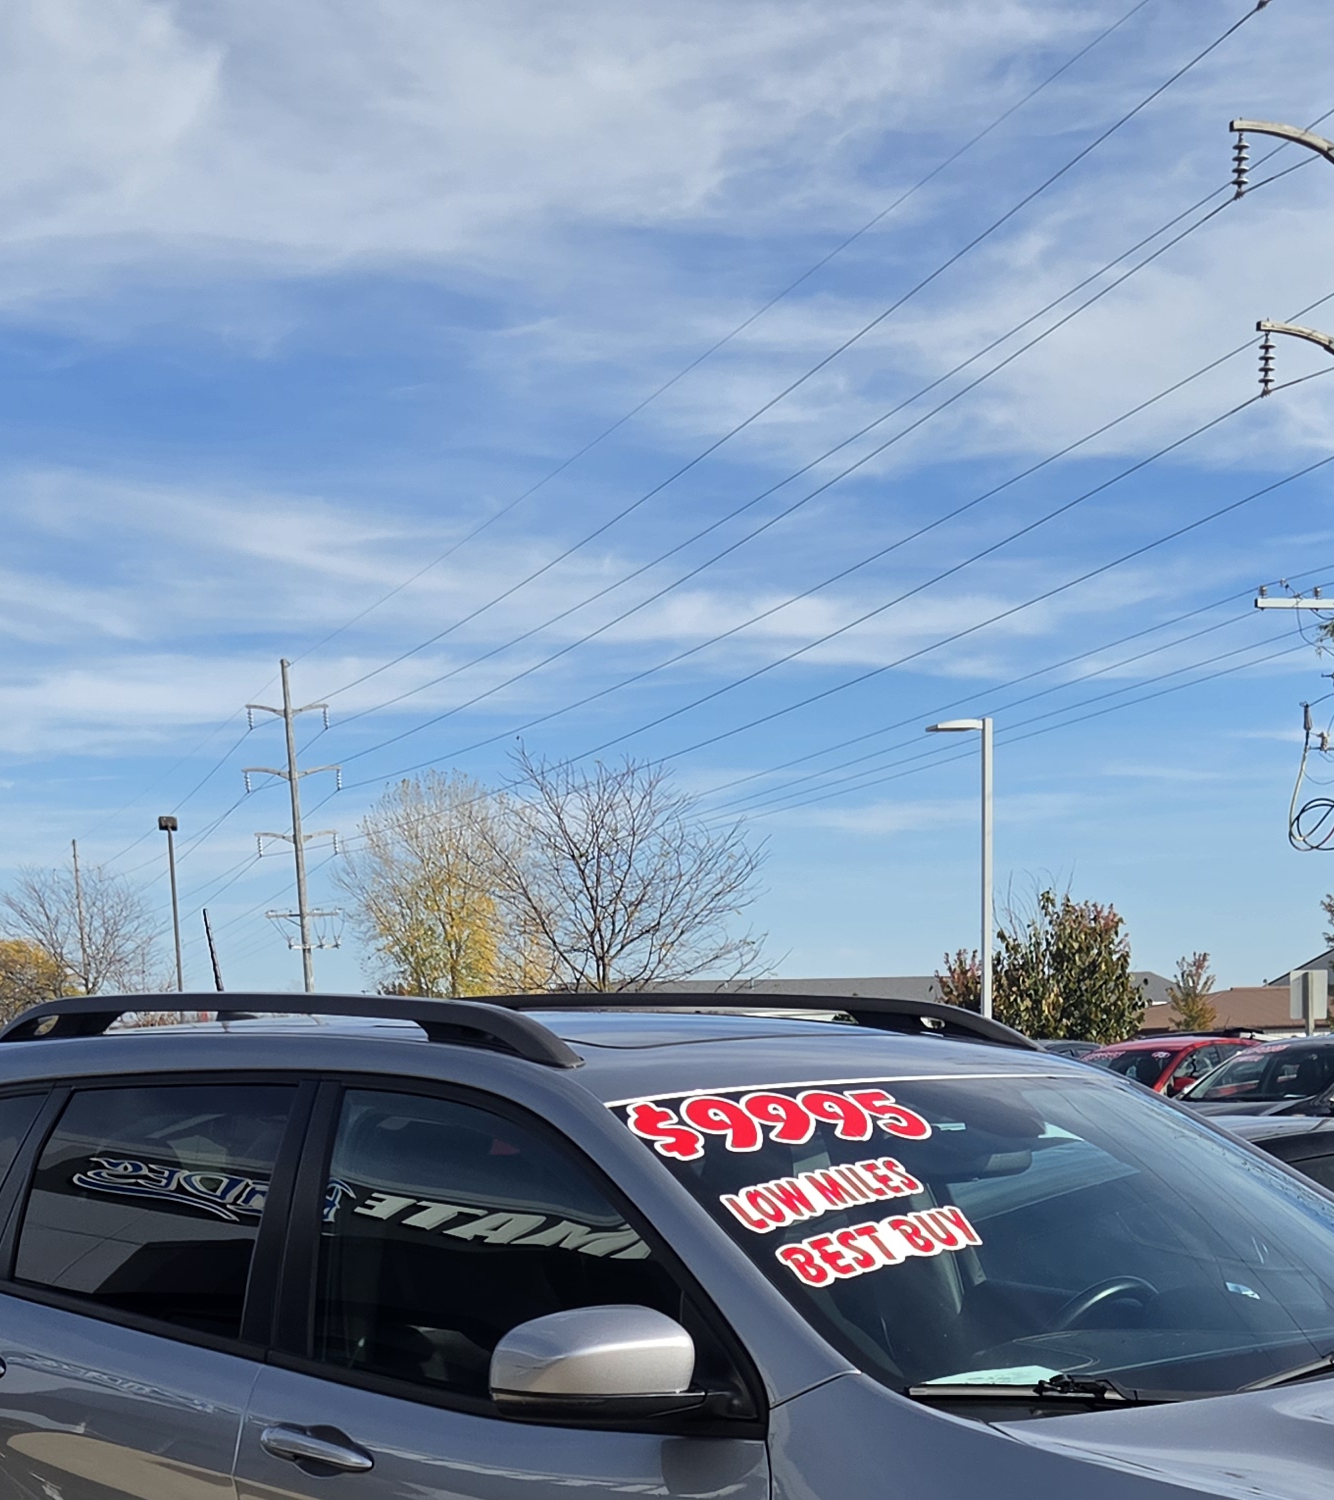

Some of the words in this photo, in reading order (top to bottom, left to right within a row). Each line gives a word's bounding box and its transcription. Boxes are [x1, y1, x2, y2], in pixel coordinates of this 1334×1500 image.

[627, 1090, 933, 1161] $9995
[720, 1172, 817, 1234] LOW
[805, 1156, 925, 1212] MILES
[775, 1221, 895, 1287] BEST
[888, 1205, 983, 1258] BUY
